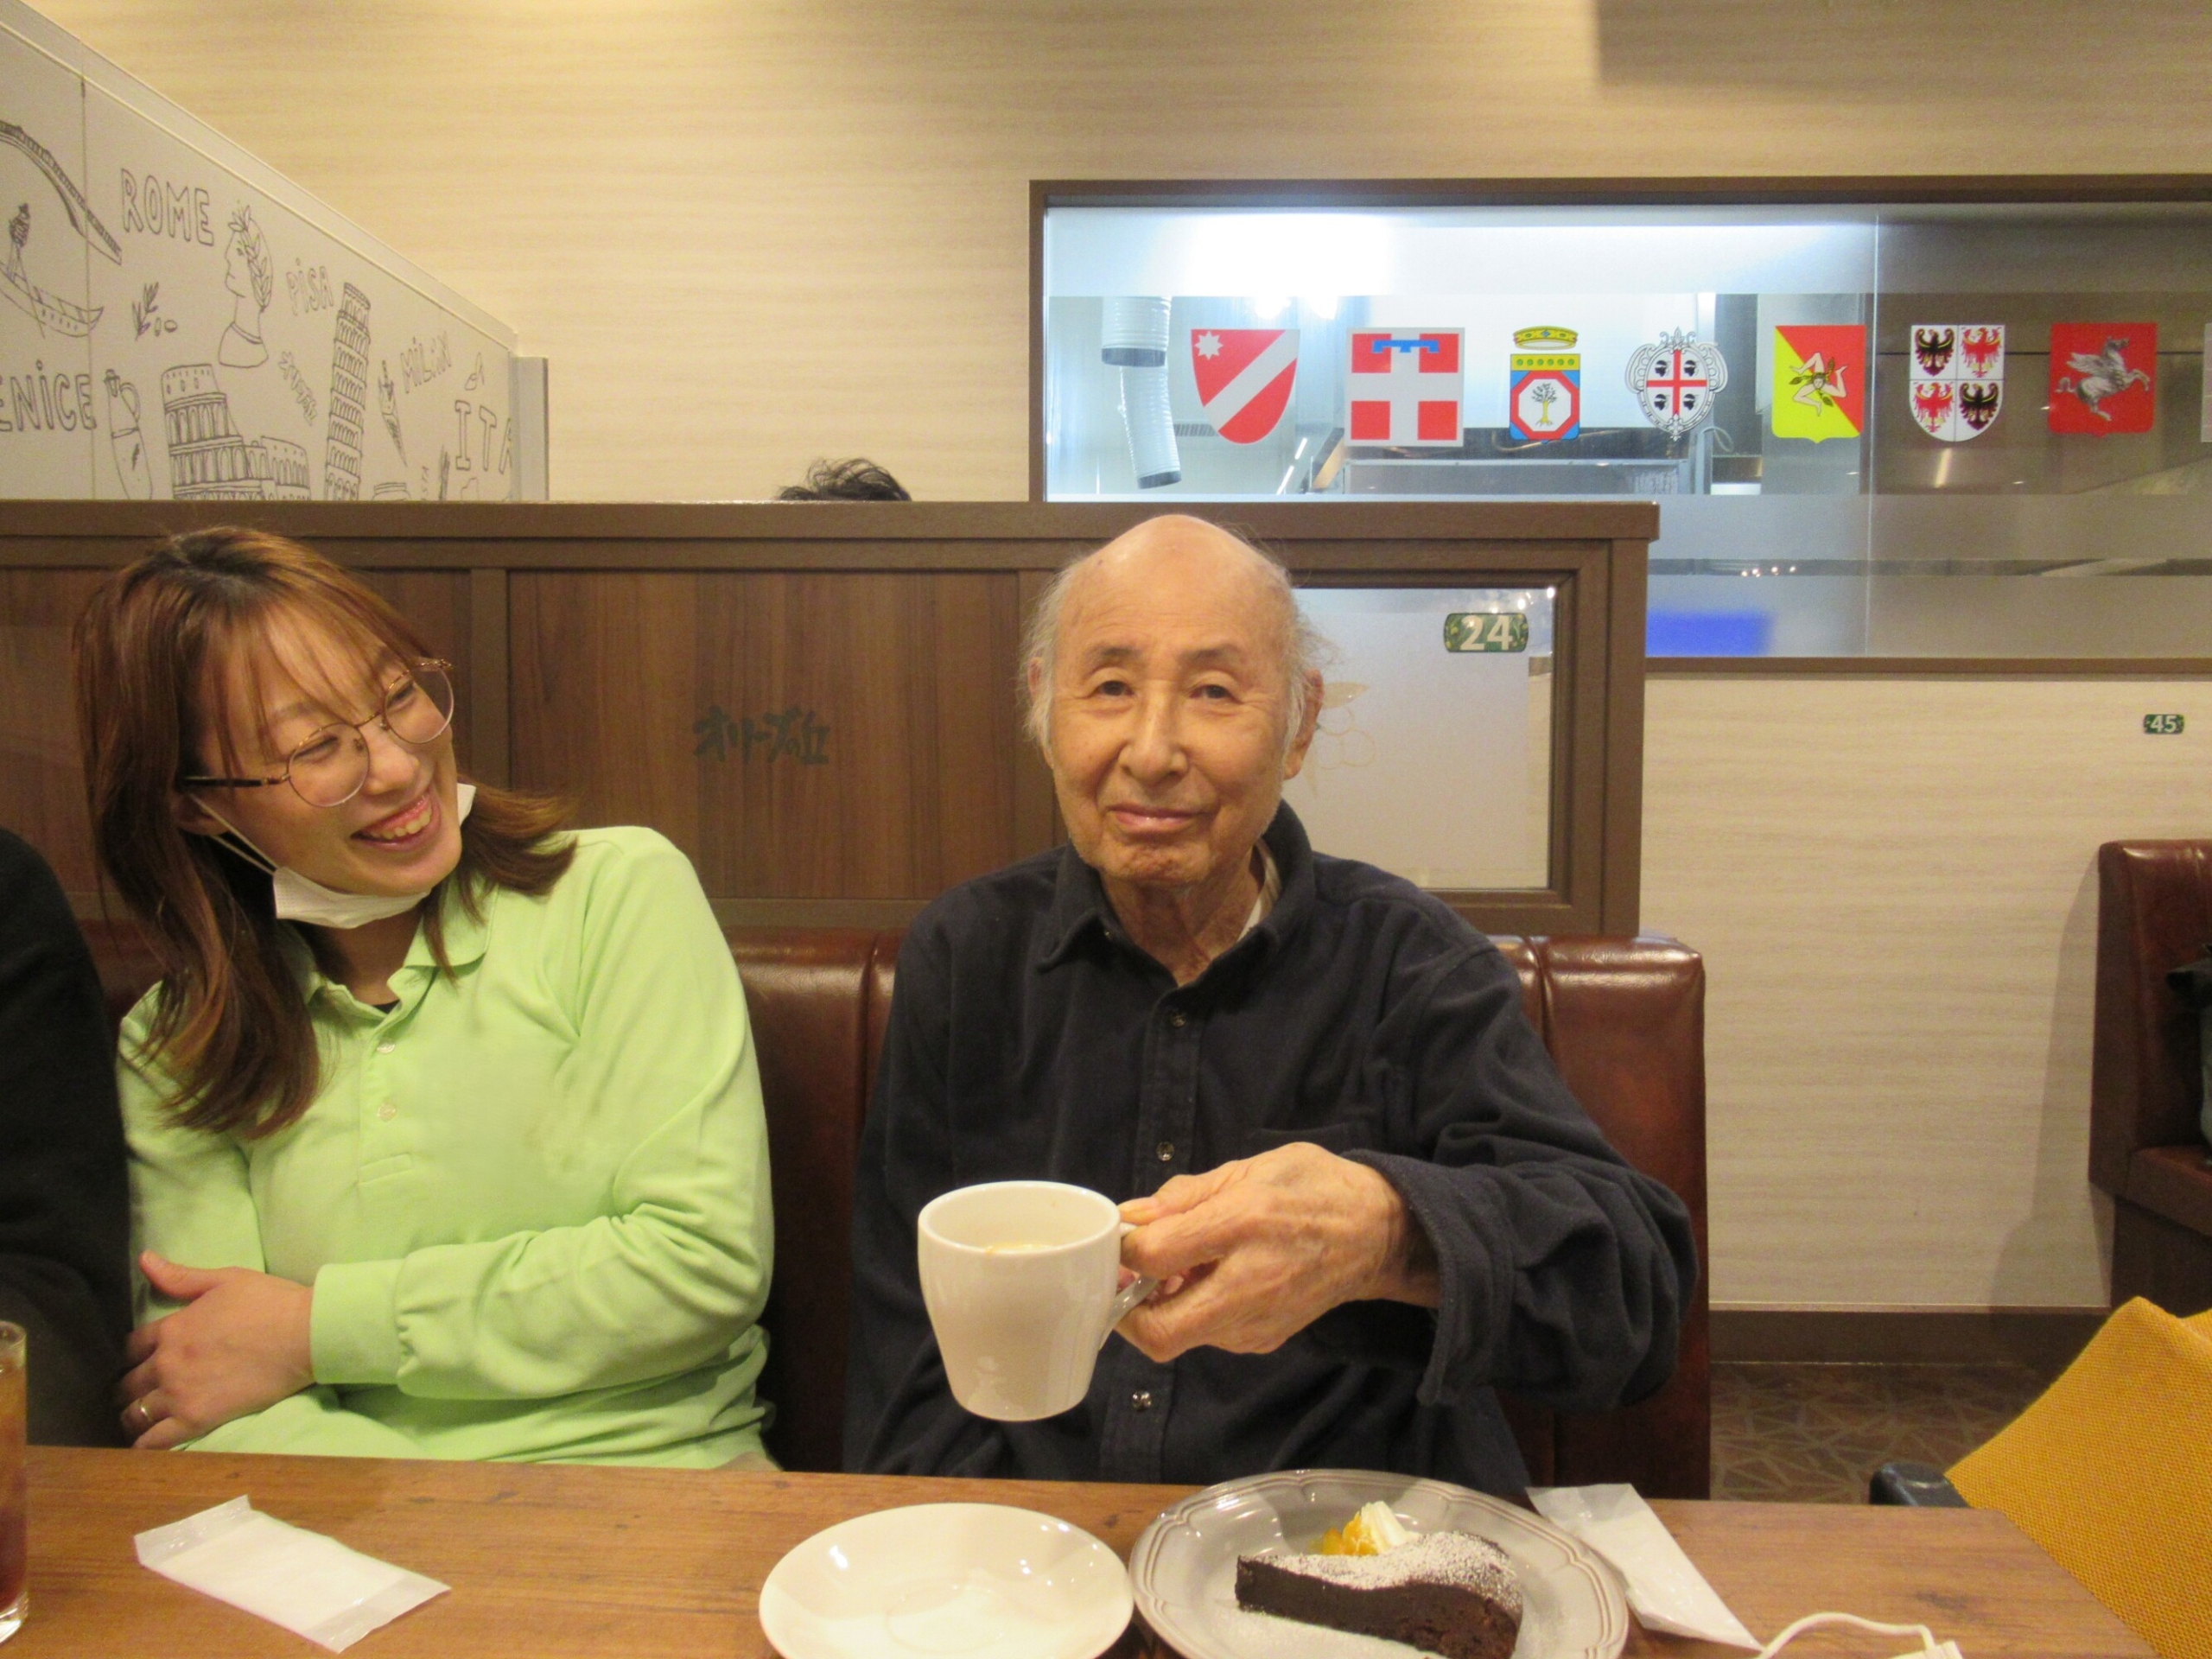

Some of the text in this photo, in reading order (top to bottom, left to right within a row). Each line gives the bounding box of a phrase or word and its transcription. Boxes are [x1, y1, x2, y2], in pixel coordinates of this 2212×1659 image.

[121, 168, 214, 246] ROME
[1460, 614, 1513, 651] 24
[693, 704, 830, 765] オリーブの丘
[2150, 715, 2177, 733] 45
